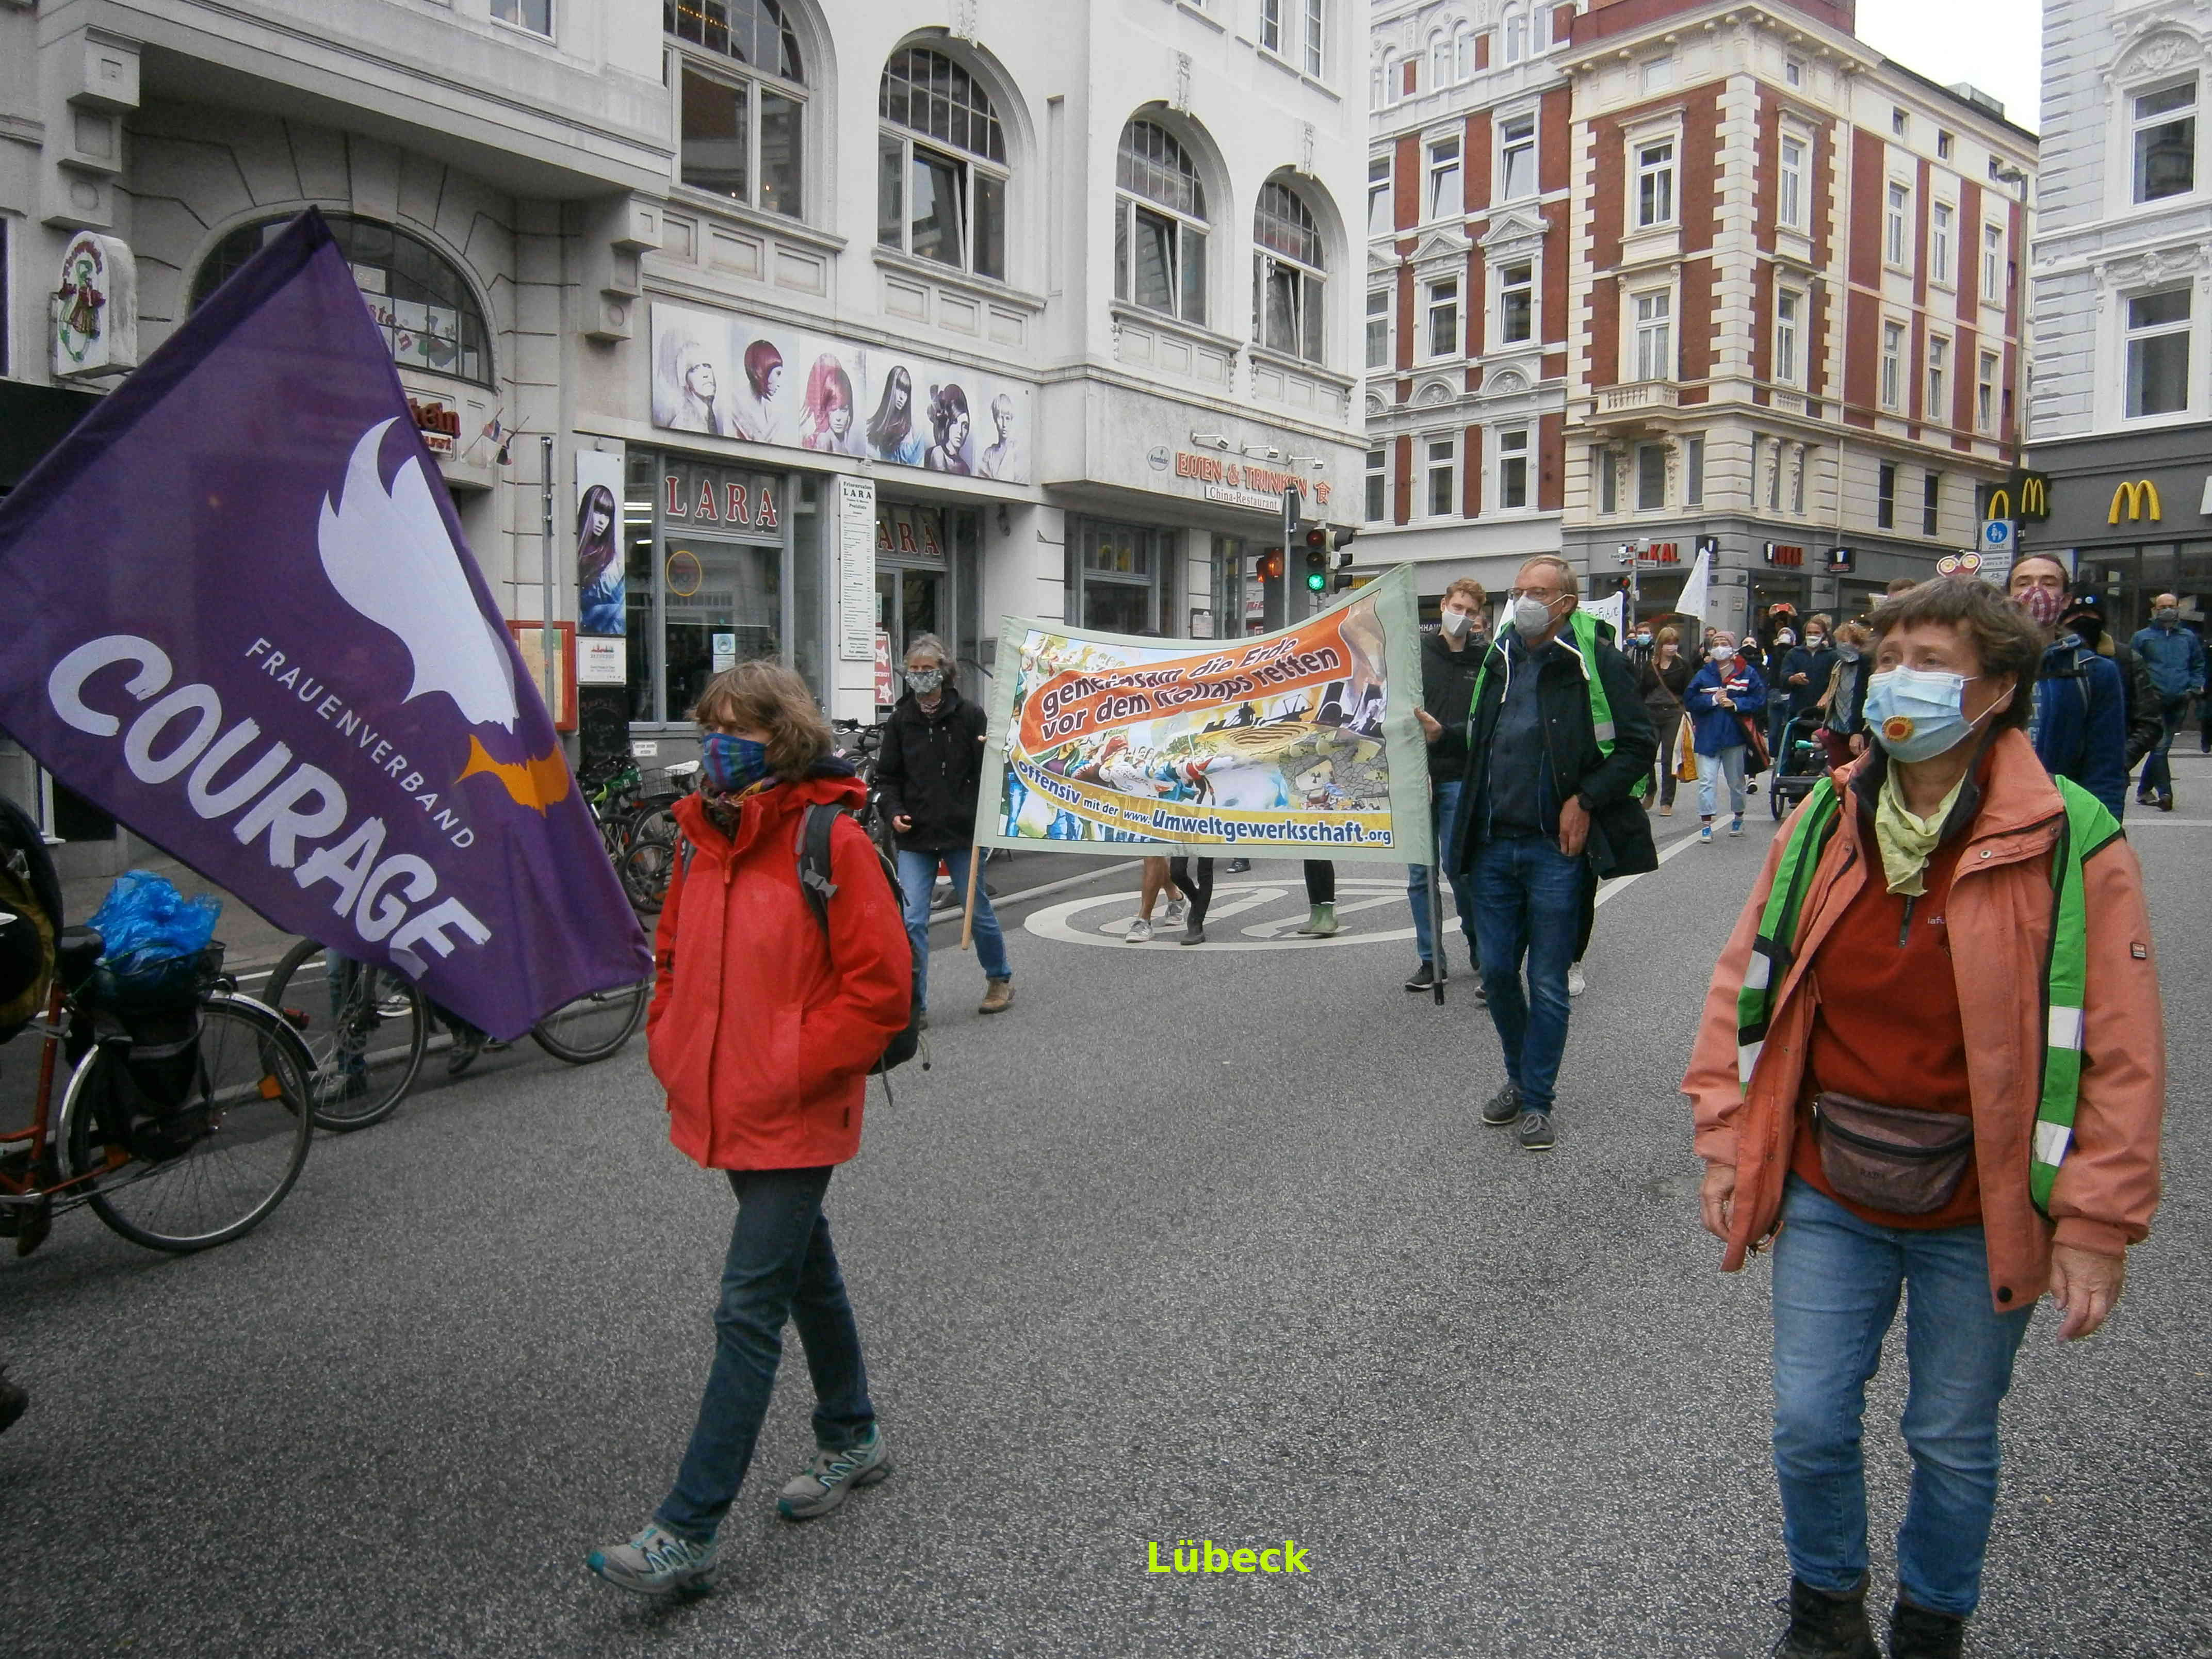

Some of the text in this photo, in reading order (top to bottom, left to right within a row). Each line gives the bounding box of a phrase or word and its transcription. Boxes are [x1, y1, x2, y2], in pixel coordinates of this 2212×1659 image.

[843, 488, 872, 499] LARA
[1177, 452, 1222, 482] ESSEN
[1228, 462, 1240, 485] &
[1314, 480, 1331, 505] 食
[665, 475, 778, 527] LARA
[1210, 486, 1278, 510] China-Restaurant
[876, 521, 940, 556] ARA
[1042, 647, 1339, 741] vor dem Kollaps retten
[1043, 638, 1298, 719] gemeinsam die Erde
[246, 637, 475, 849] FRAUENVERBAND
[48, 634, 492, 981] COURAGE
[1018, 760, 1081, 804] offensiv
[1083, 799, 1100, 811] mit
[1102, 803, 1119, 816] der
